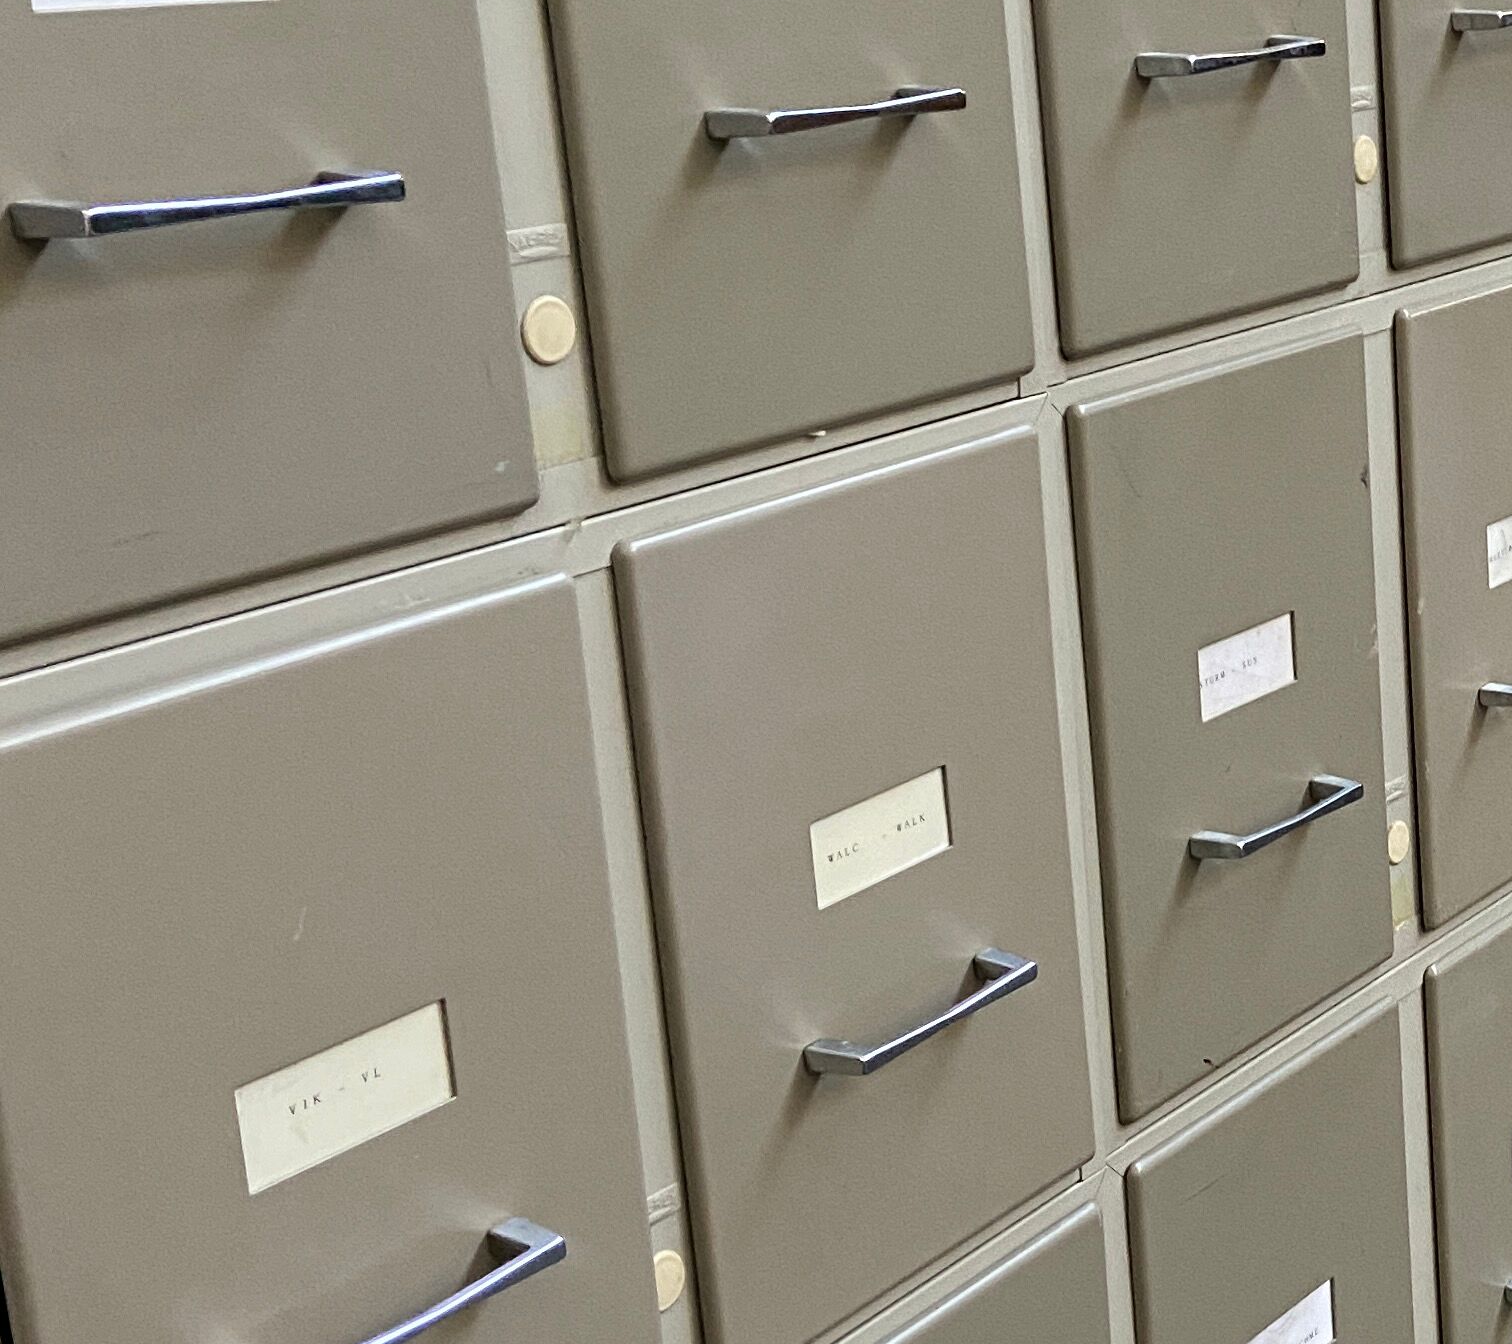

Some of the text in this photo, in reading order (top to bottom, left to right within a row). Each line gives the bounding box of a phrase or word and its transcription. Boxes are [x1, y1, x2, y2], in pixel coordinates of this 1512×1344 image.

[828, 843, 859, 863] WALC
[289, 1094, 321, 1115] VIK
[361, 1068, 382, 1083] VL
